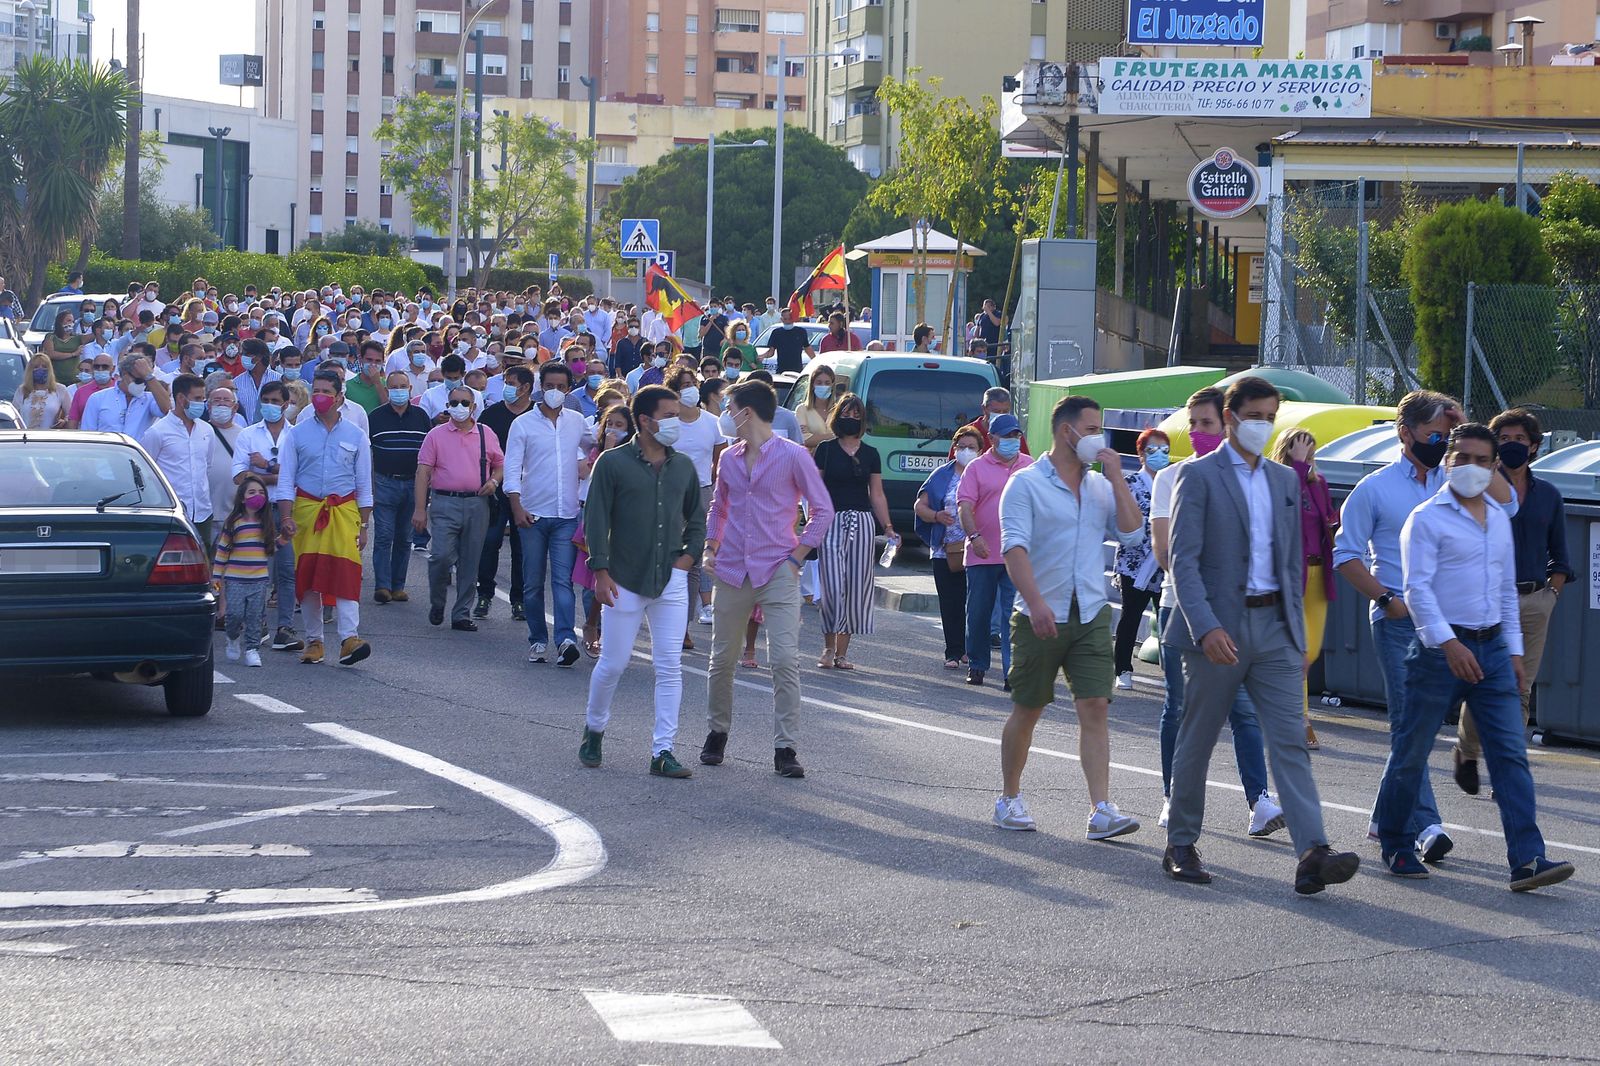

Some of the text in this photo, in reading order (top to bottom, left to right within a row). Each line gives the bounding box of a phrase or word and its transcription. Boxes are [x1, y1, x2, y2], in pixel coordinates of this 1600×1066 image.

[1137, 7, 1259, 41] El Juzgado
[1113, 61, 1363, 80] FRUTERIA MARISA
[1111, 79, 1360, 94] CALIDAD PRECIO Y SERVICIO
[1115, 91, 1195, 102] ALIMENTACION
[1119, 101, 1193, 112] CHARCUTERIA
[1215, 98, 1249, 109] 956-66
[1199, 171, 1247, 184] Estrella
[1201, 184, 1245, 197] Galicia
[907, 457, 934, 467] 5846
